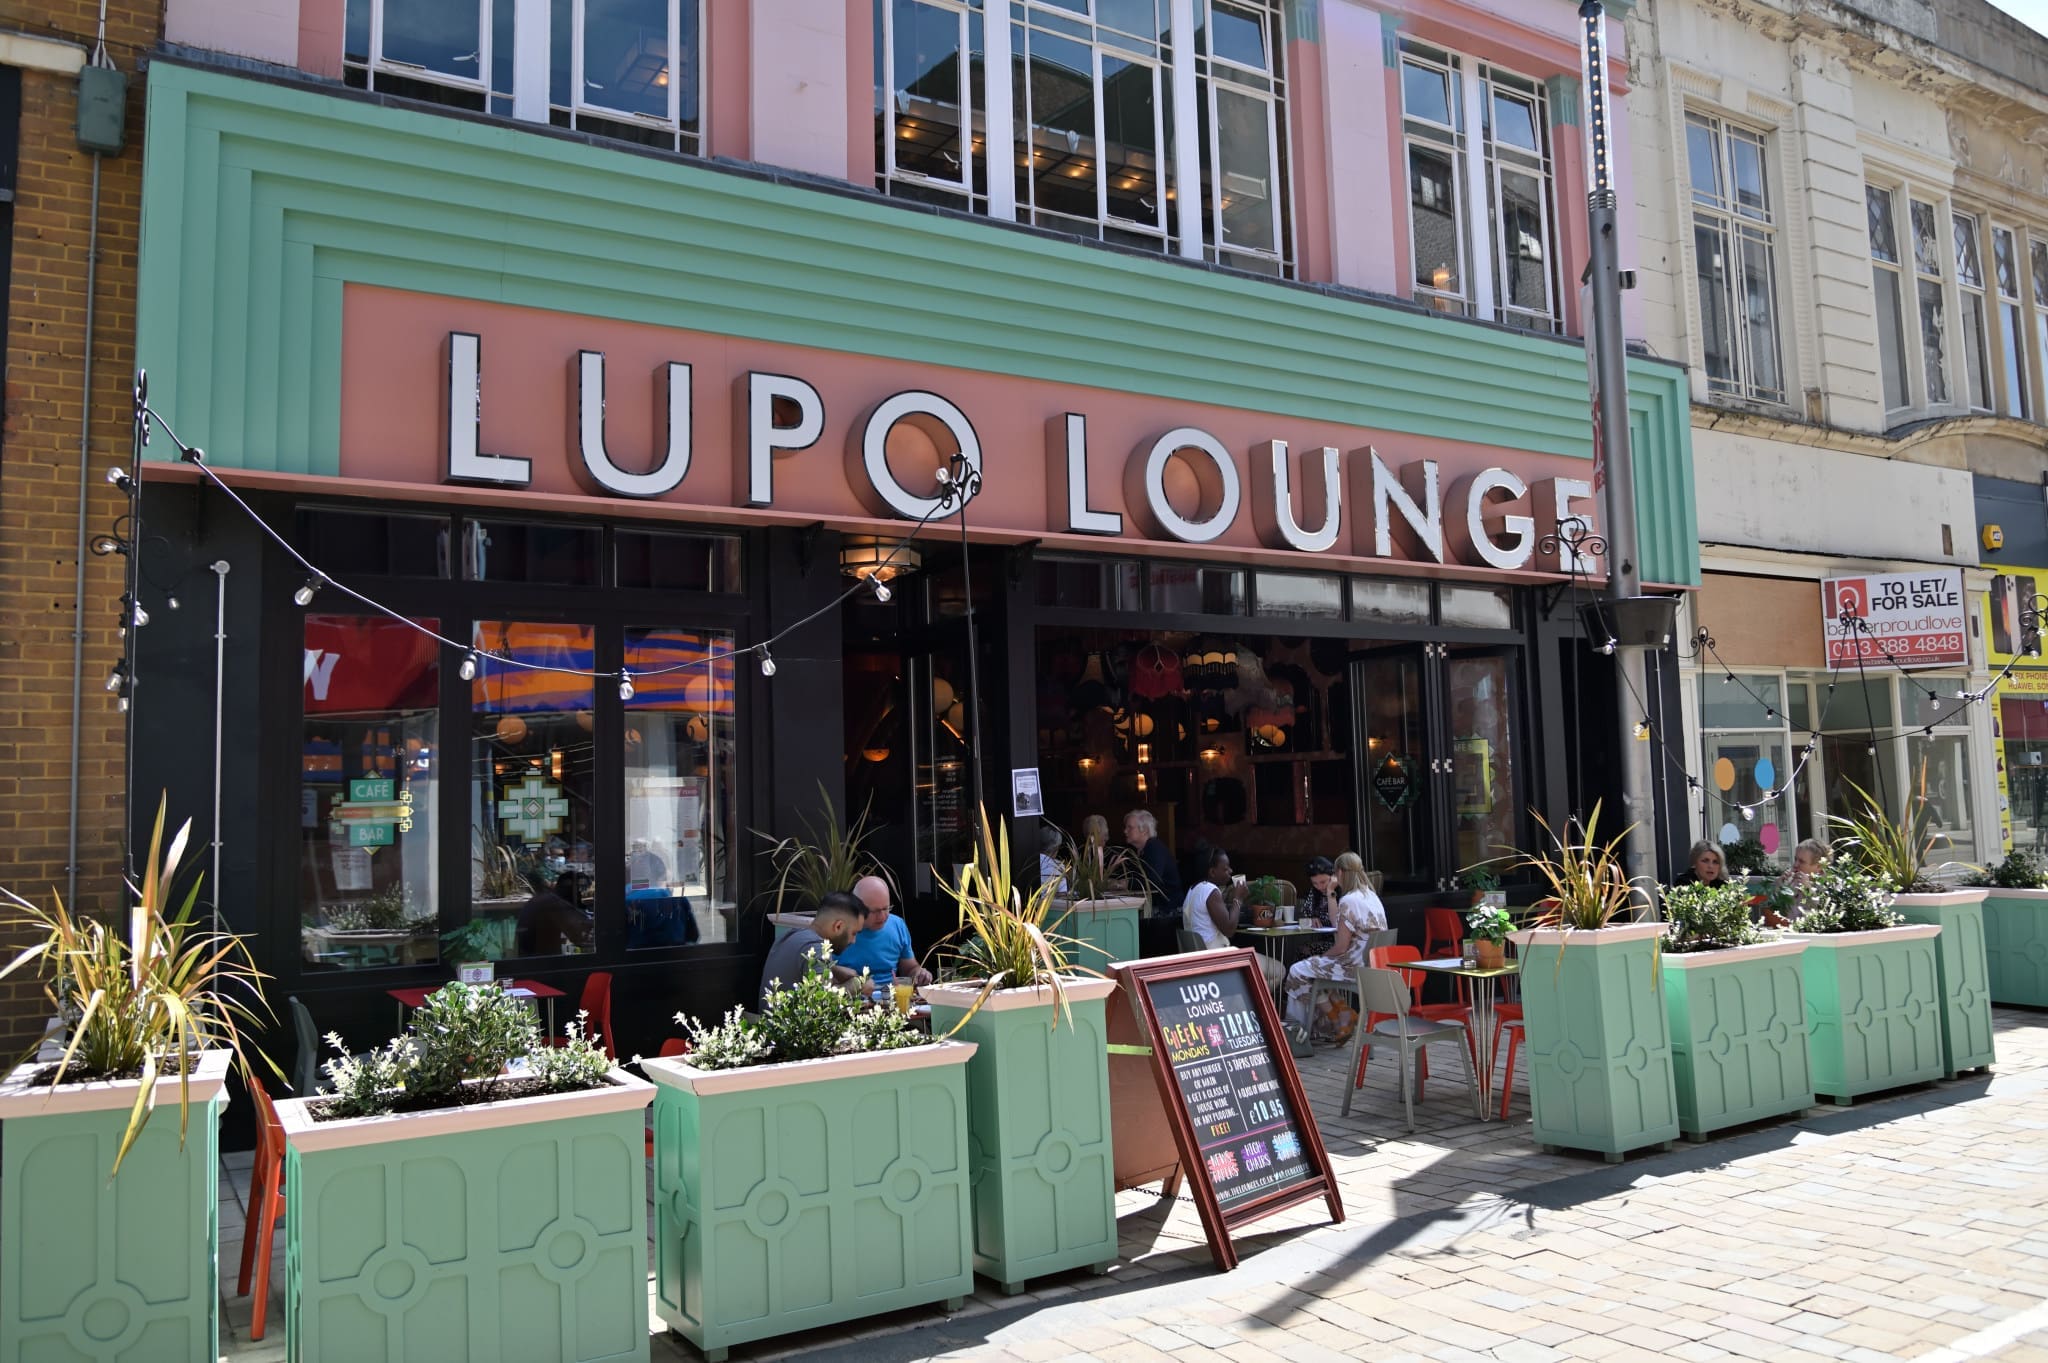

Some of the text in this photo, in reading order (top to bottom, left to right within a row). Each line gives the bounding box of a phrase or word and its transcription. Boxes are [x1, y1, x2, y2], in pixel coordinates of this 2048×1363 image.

[446, 331, 983, 523] LUPO
[1054, 411, 1598, 574] LOUNGE
[1880, 578, 1947, 596] TO LET/
[1872, 592, 1959, 611] FOR SALE
[1832, 635, 1960, 657] 0113 388 4848
[355, 781, 389, 798] CAFÉ
[359, 828, 384, 841] BAR
[1179, 981, 1220, 1004] LUPO
[1186, 1001, 1225, 1019] LOUNGE
[1219, 1010, 1261, 1039] TAPAS
[1163, 1021, 1206, 1050] CHEEKY
[1228, 1033, 1265, 1050] TUESDAYS
[1171, 1044, 1210, 1063] MONDAYS
[1227, 1060, 1233, 1072] 3
[1231, 1056, 1250, 1071] TAPAS
[1206, 1086, 1222, 1098] GLASS
[1249, 1098, 1285, 1125] £10.95
[1210, 1121, 1231, 1137] FREE!
